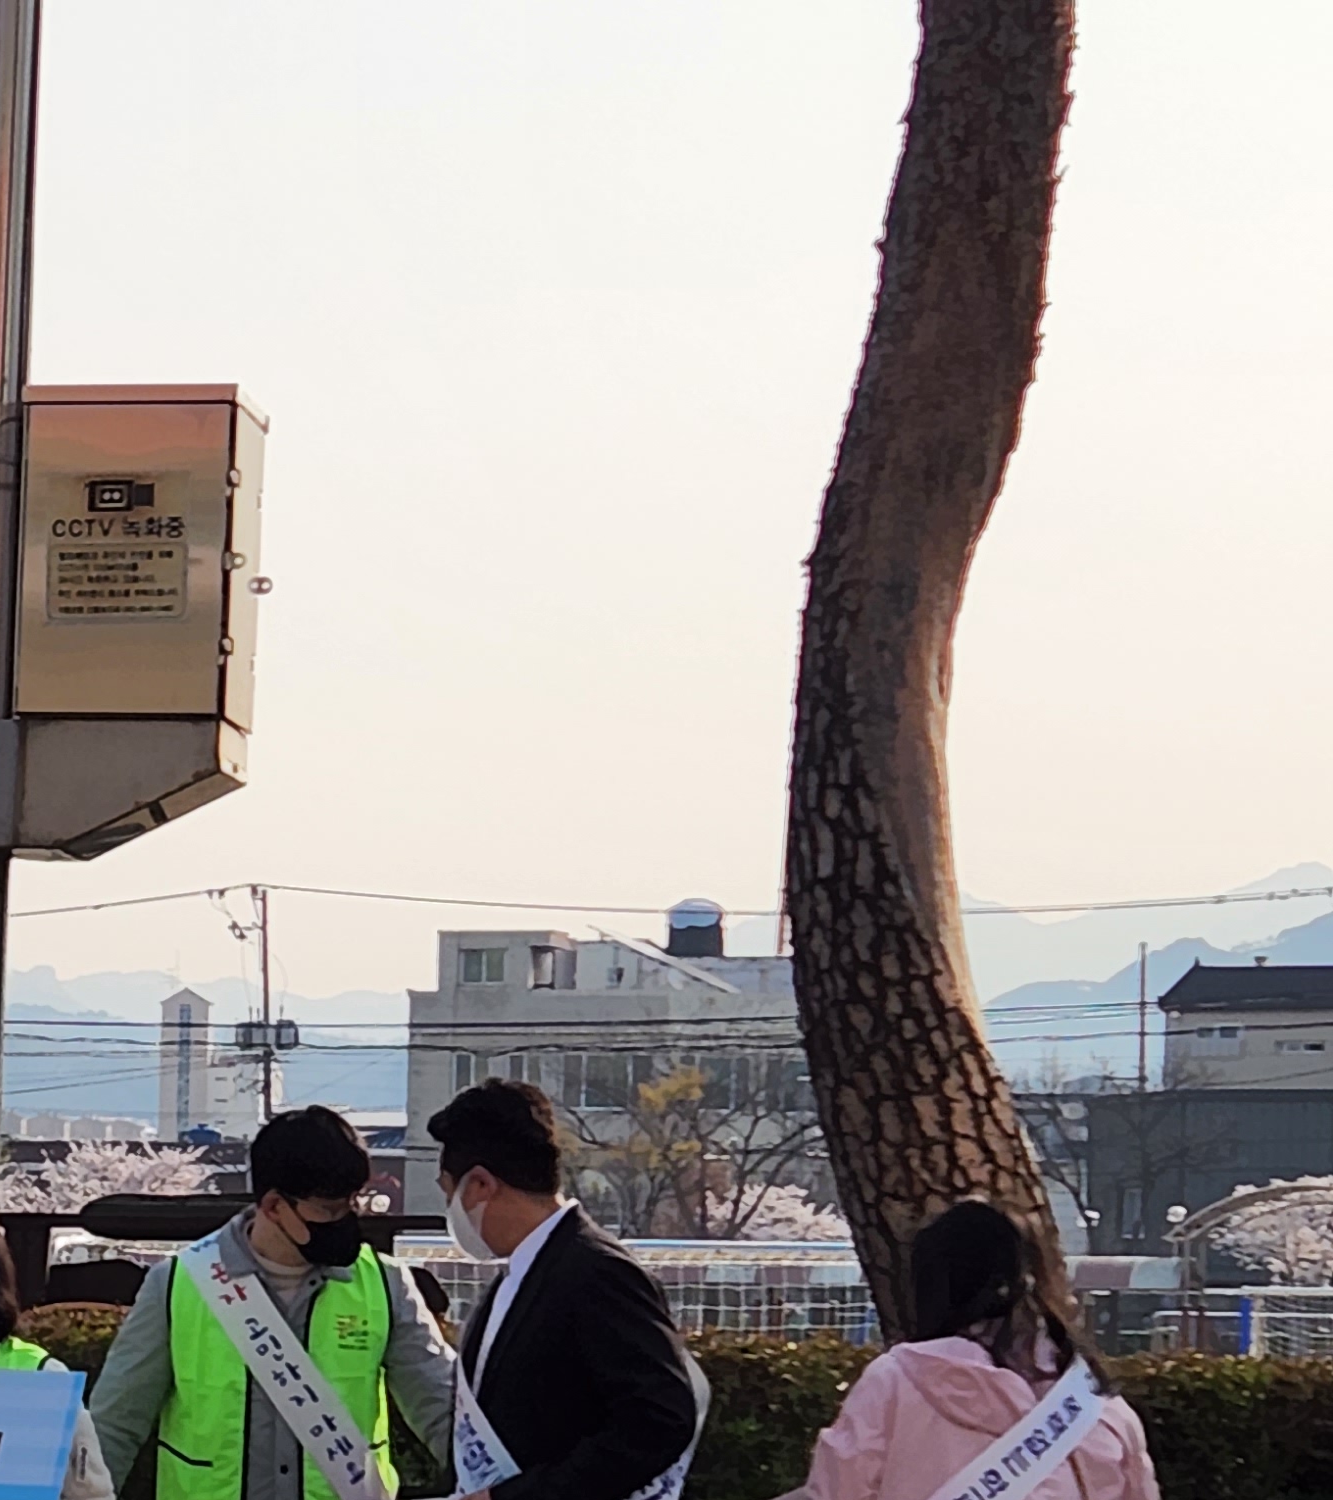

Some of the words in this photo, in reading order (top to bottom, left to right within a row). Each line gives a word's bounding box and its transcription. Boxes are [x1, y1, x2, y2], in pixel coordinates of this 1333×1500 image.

[51, 518, 114, 538] CCTV
[121, 515, 186, 539] 녹화중
[244, 1316, 320, 1408] 고민하지
[309, 1412, 367, 1486] 마세요
